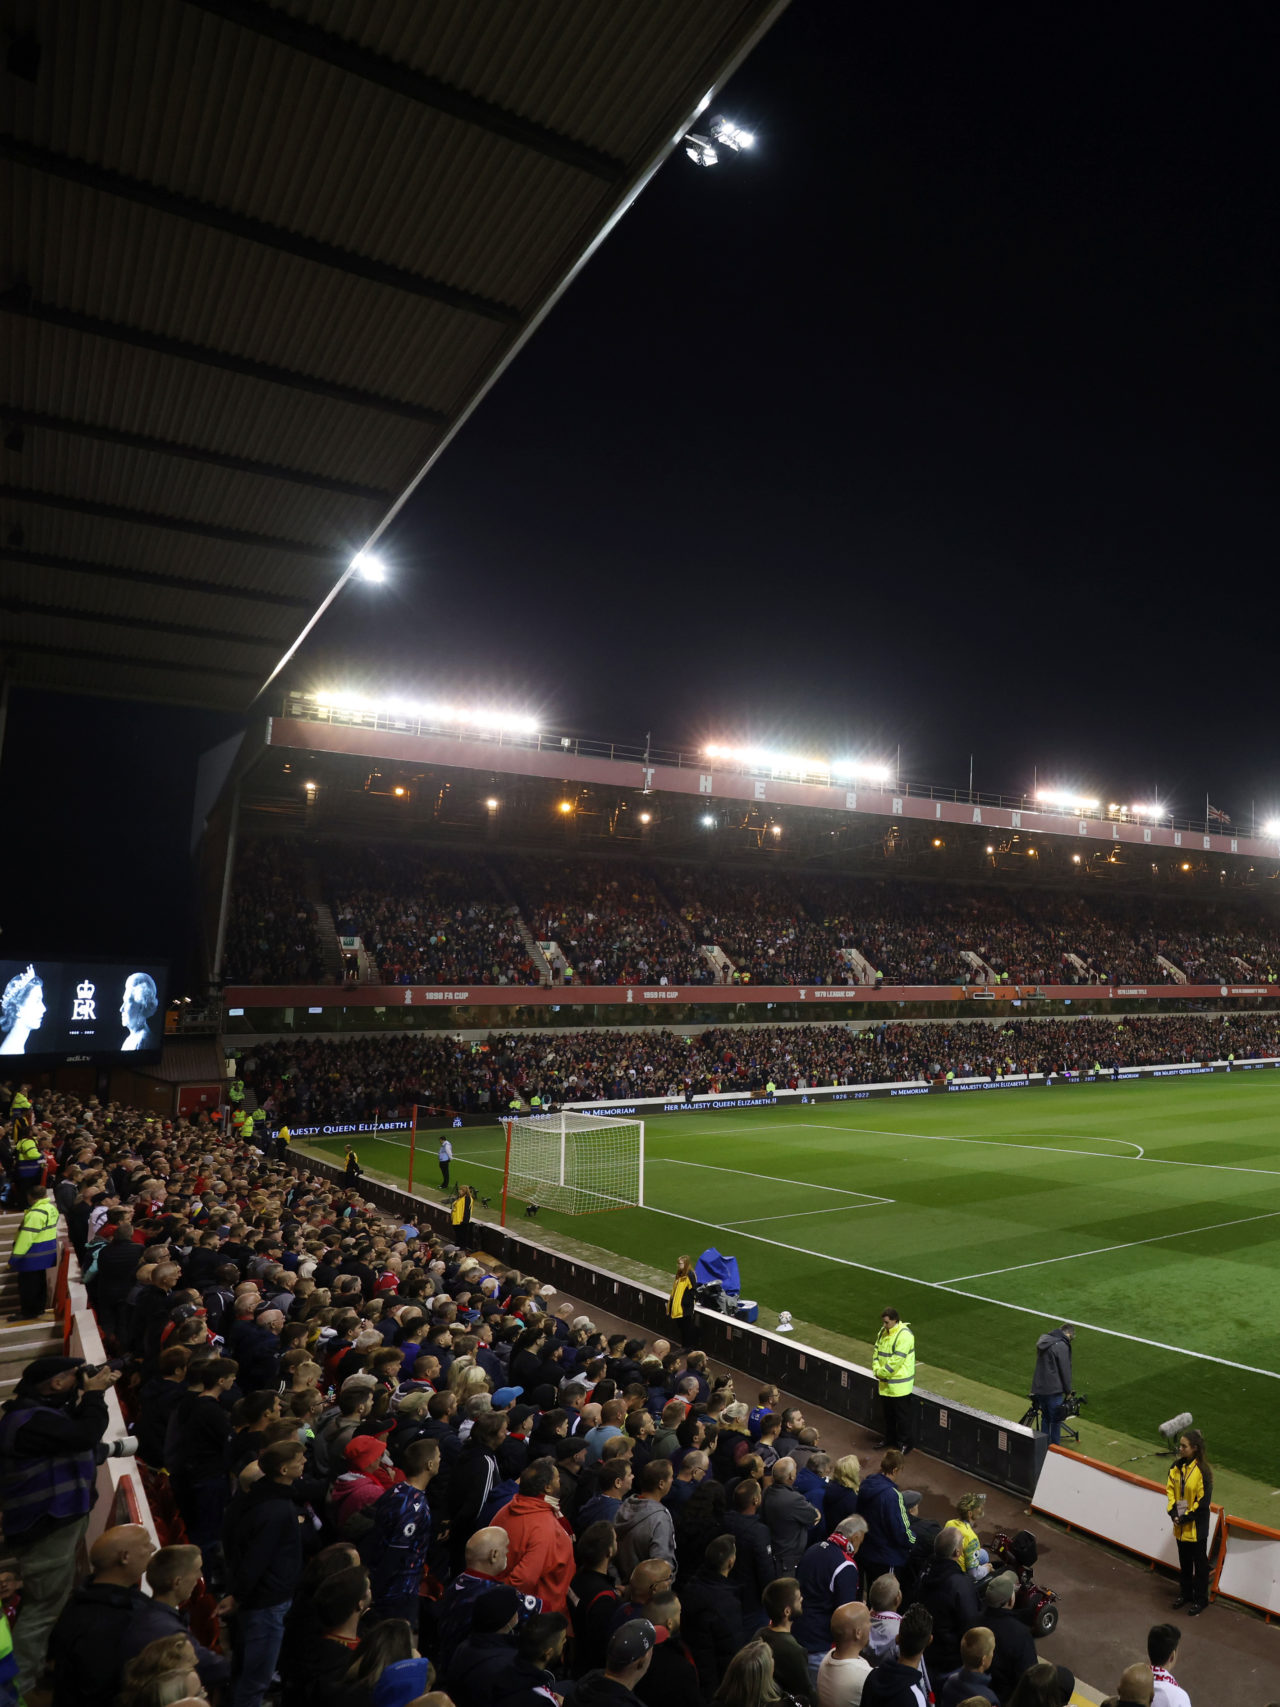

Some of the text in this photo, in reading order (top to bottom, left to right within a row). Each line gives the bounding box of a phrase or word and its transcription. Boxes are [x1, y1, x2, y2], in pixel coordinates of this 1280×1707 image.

[454, 992, 469, 1000] CUP
[667, 991, 679, 999] CUP
[960, 1083, 982, 1091] MAJESTY
[680, 1102, 711, 1110] MAJESTY
[712, 1100, 736, 1108] QUEEN
[737, 1098, 771, 1106] ELIZABETH
[592, 1107, 636, 1115] MEMORIAM
[323, 1124, 356, 1134] QUEEN
[358, 1121, 406, 1131] ELIZABETH
